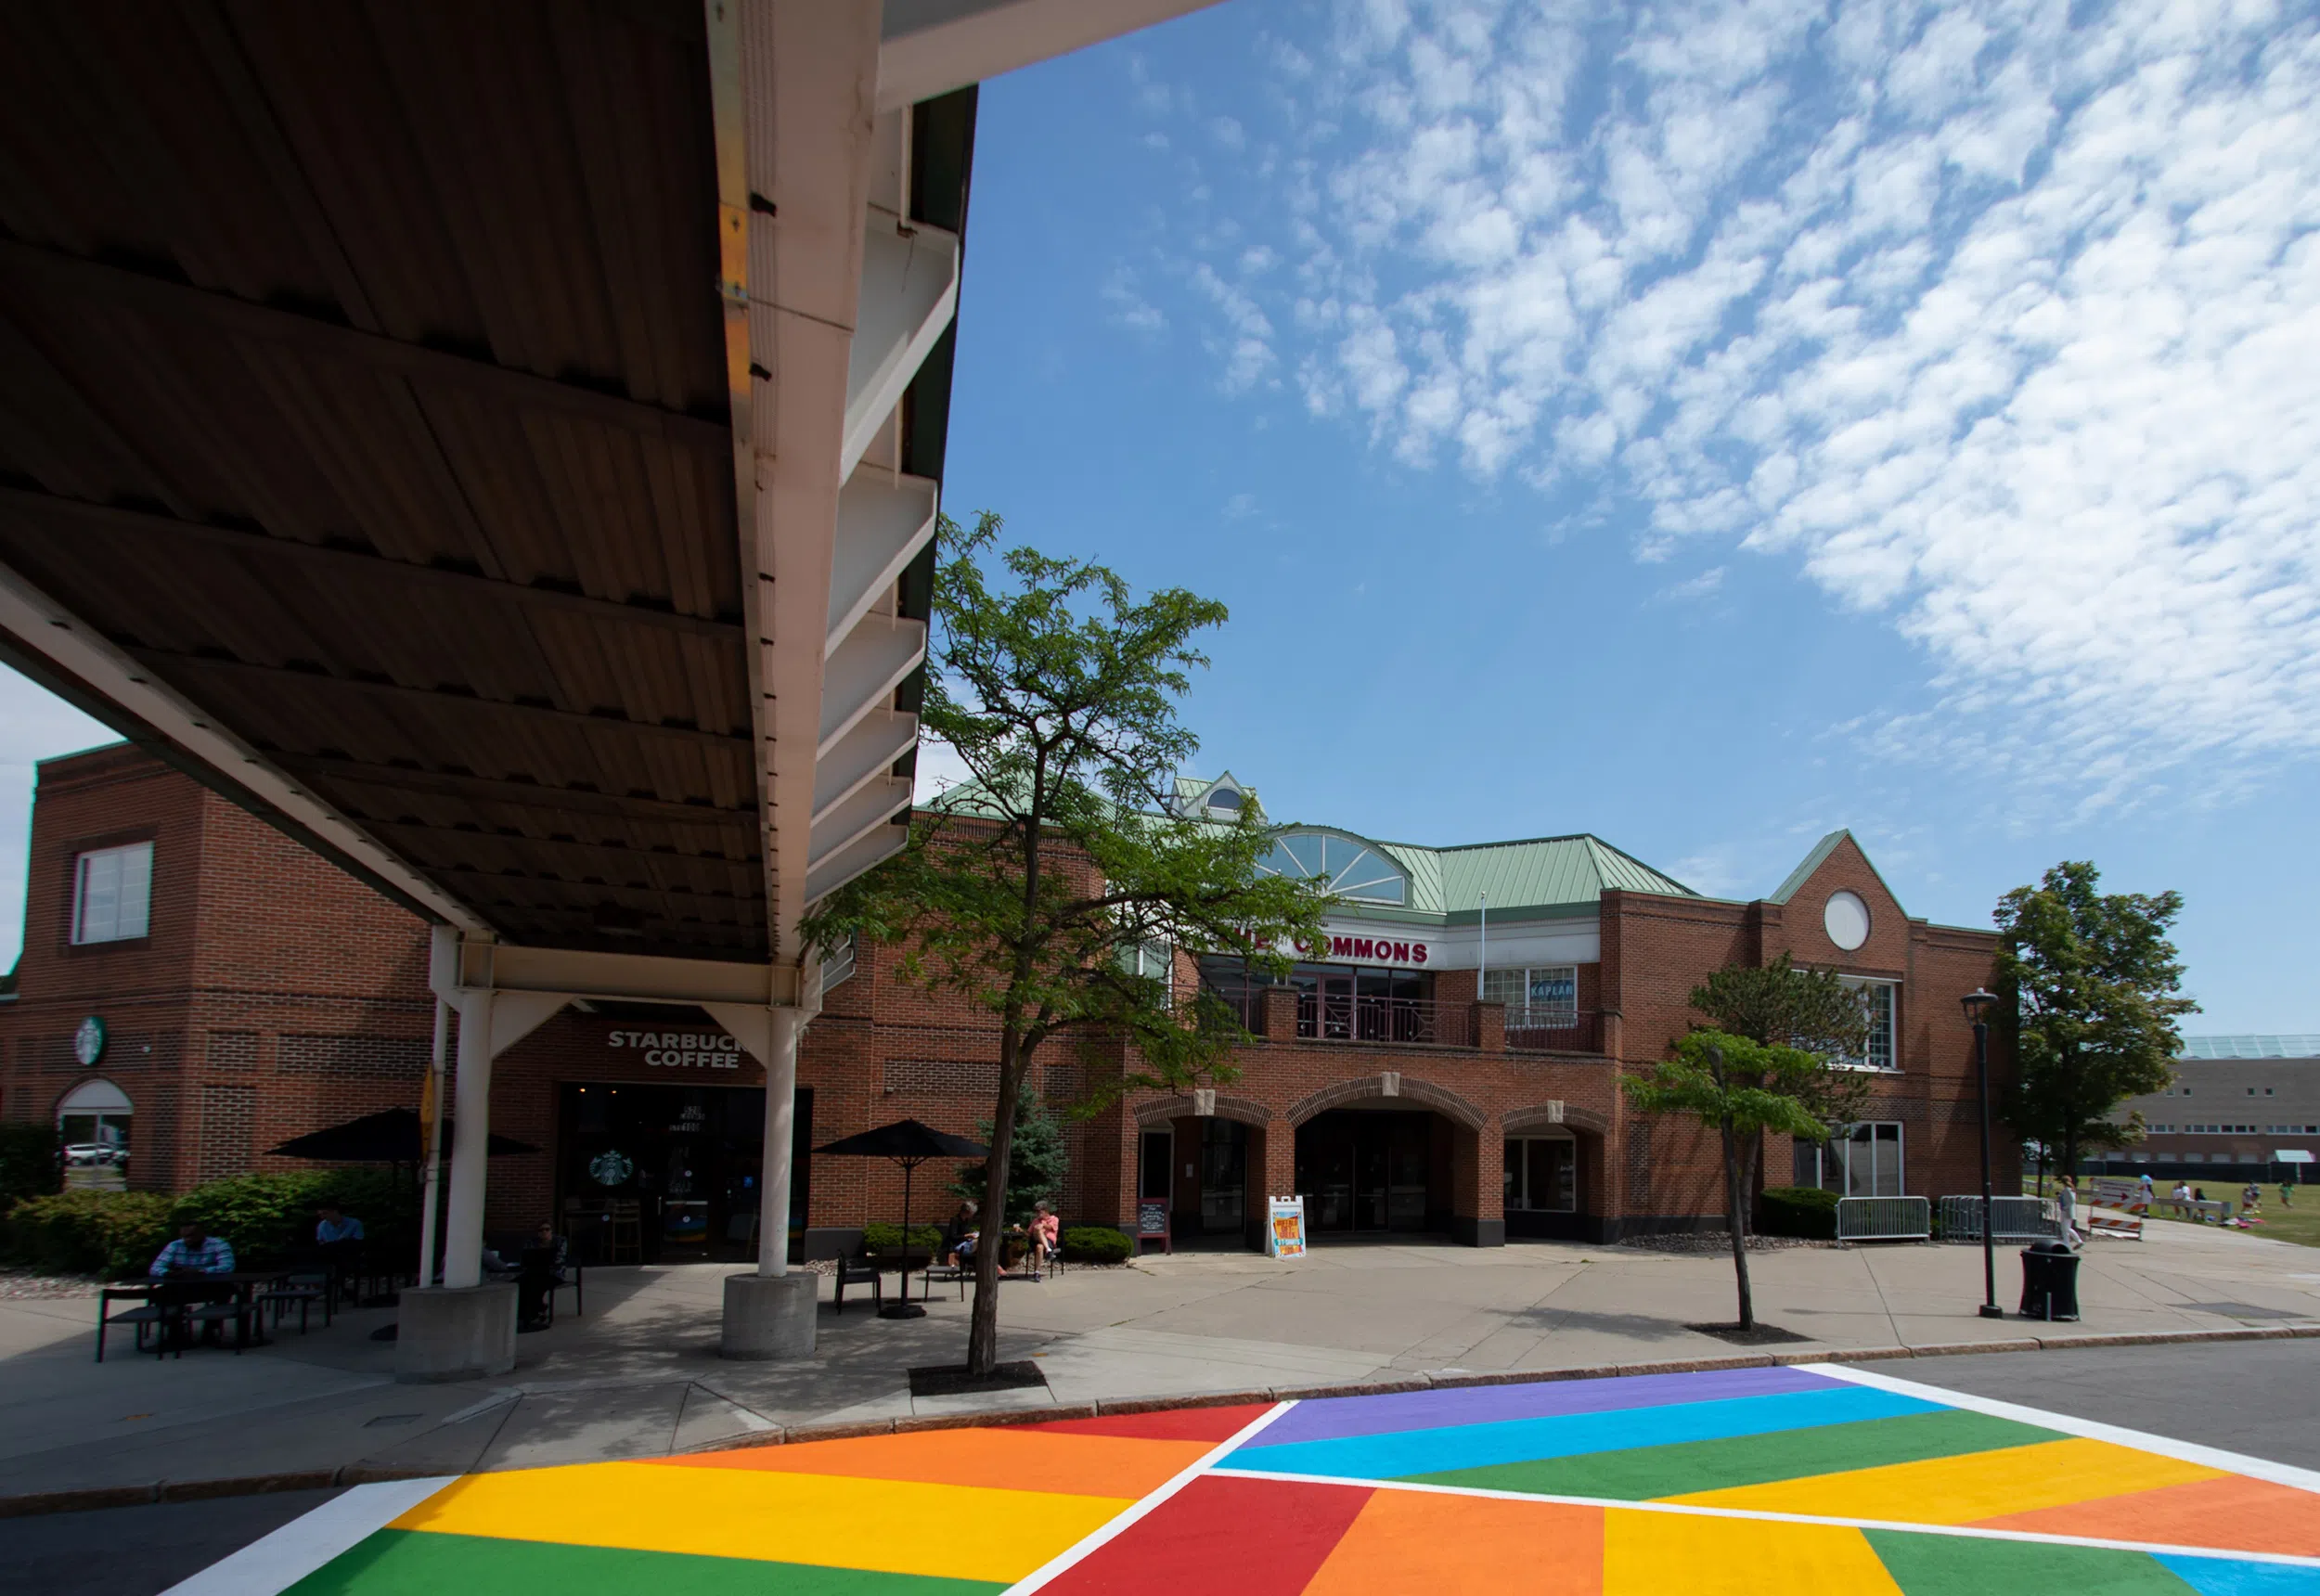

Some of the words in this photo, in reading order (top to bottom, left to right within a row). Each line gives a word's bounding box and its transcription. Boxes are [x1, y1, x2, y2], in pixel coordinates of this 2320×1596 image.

[1530, 984, 1575, 998] KAPLAN
[608, 1030, 747, 1052] STARBUCK
[644, 1049, 739, 1069] COFFEE
